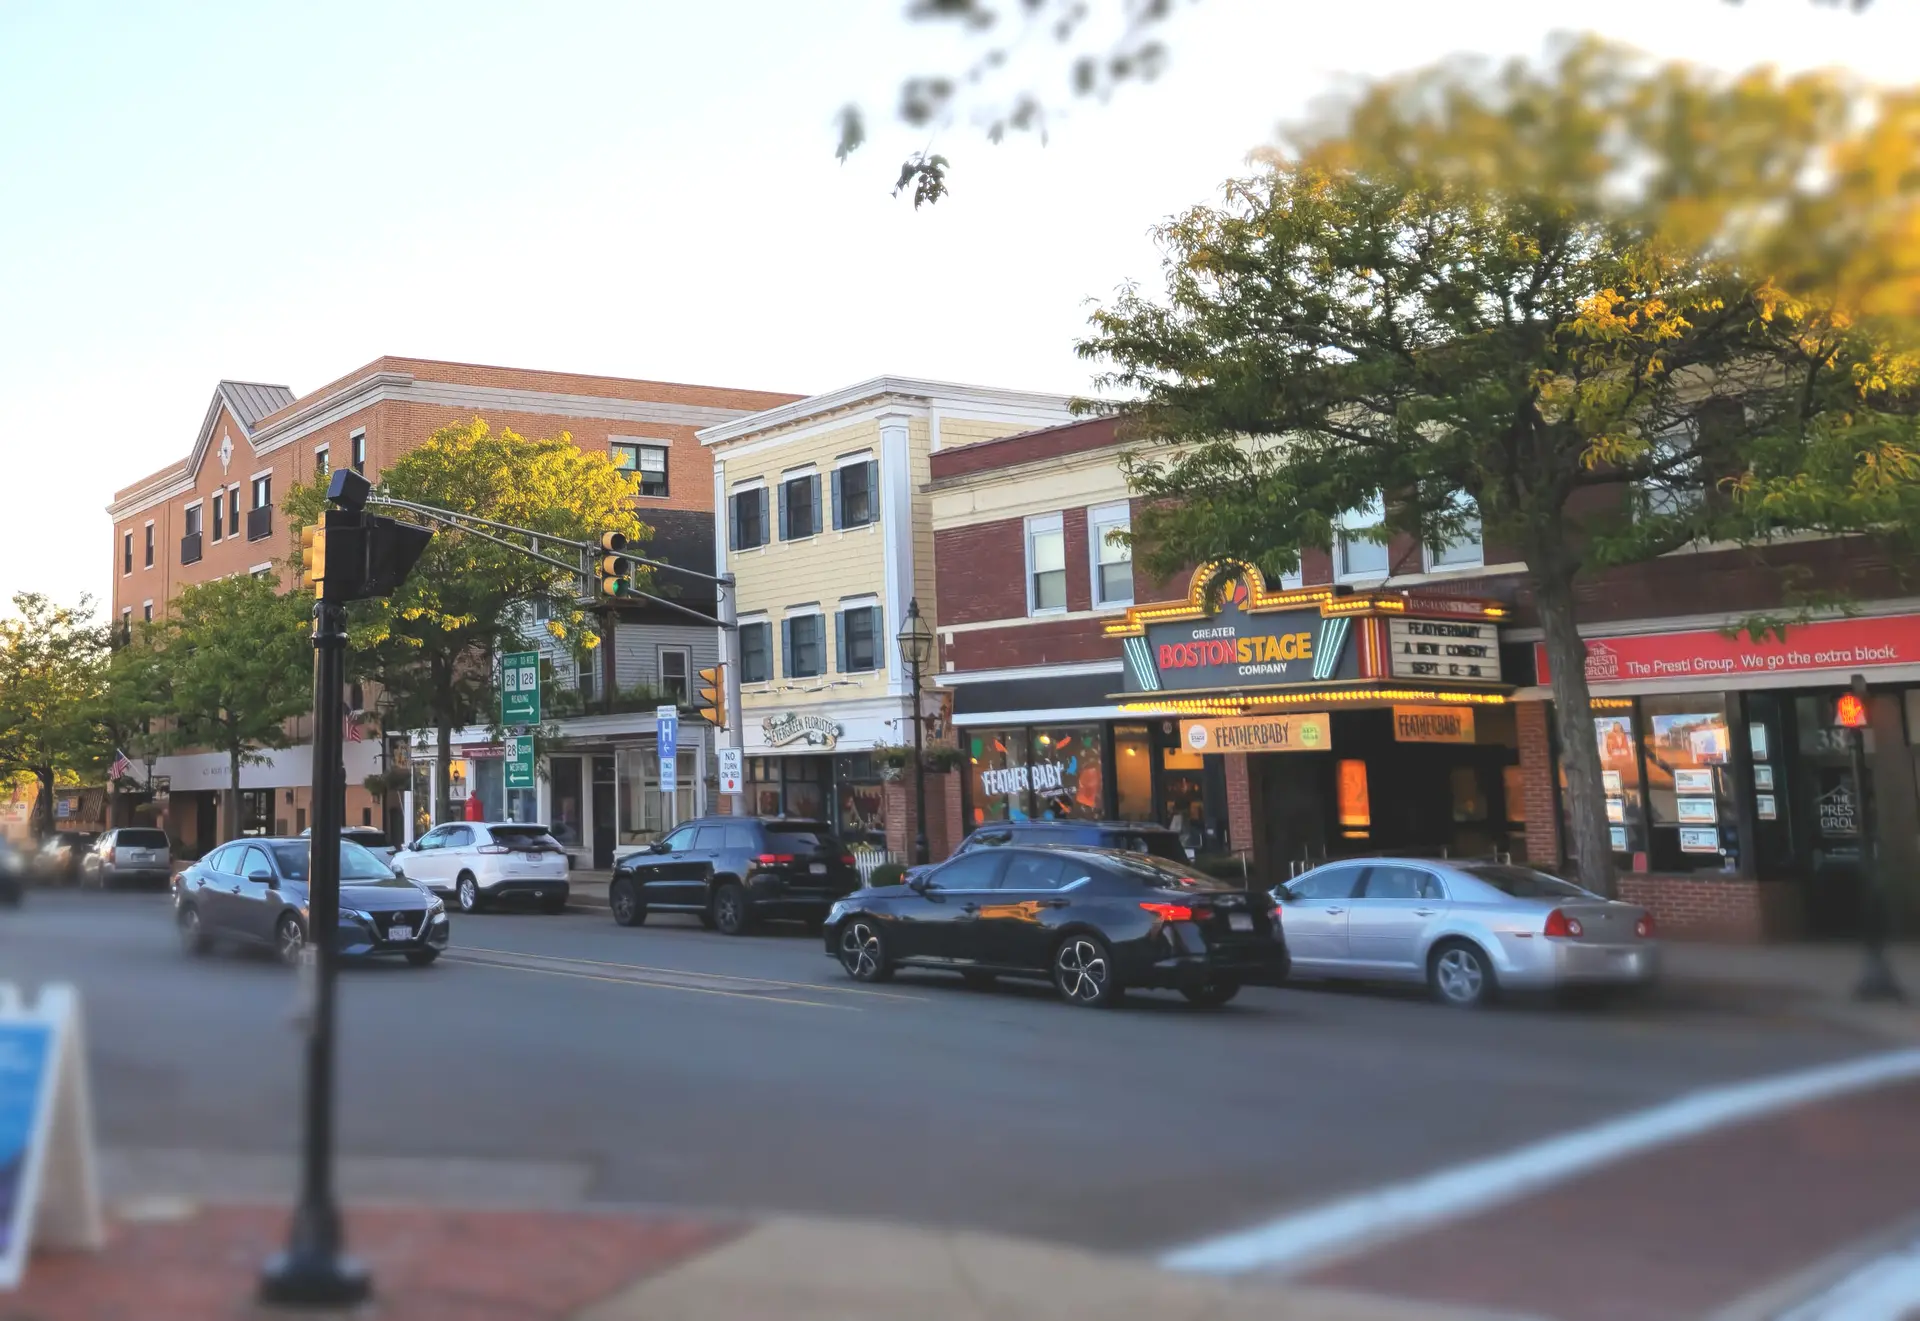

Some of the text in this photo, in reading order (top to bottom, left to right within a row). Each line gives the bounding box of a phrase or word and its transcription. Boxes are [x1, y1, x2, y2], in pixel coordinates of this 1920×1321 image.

[1192, 627, 1235, 639] GREATER
[1238, 663, 1287, 676] COMPANY
[1626, 661, 1650, 674] The
[1654, 659, 1691, 673] Presti
[1741, 654, 1763, 668] We
[1767, 655, 1784, 670] go
[1788, 652, 1811, 665] the
[1815, 650, 1851, 663] extra
[506, 672, 534, 687] 28 128
[662, 720, 672, 742] H
[771, 715, 833, 743] EVERGREEN FLORISTS
[1215, 723, 1289, 748] FEATHERBABY
[507, 744, 517, 757] 28
[725, 752, 735, 761] NO
[982, 762, 1063, 796] FEATHER BABY
